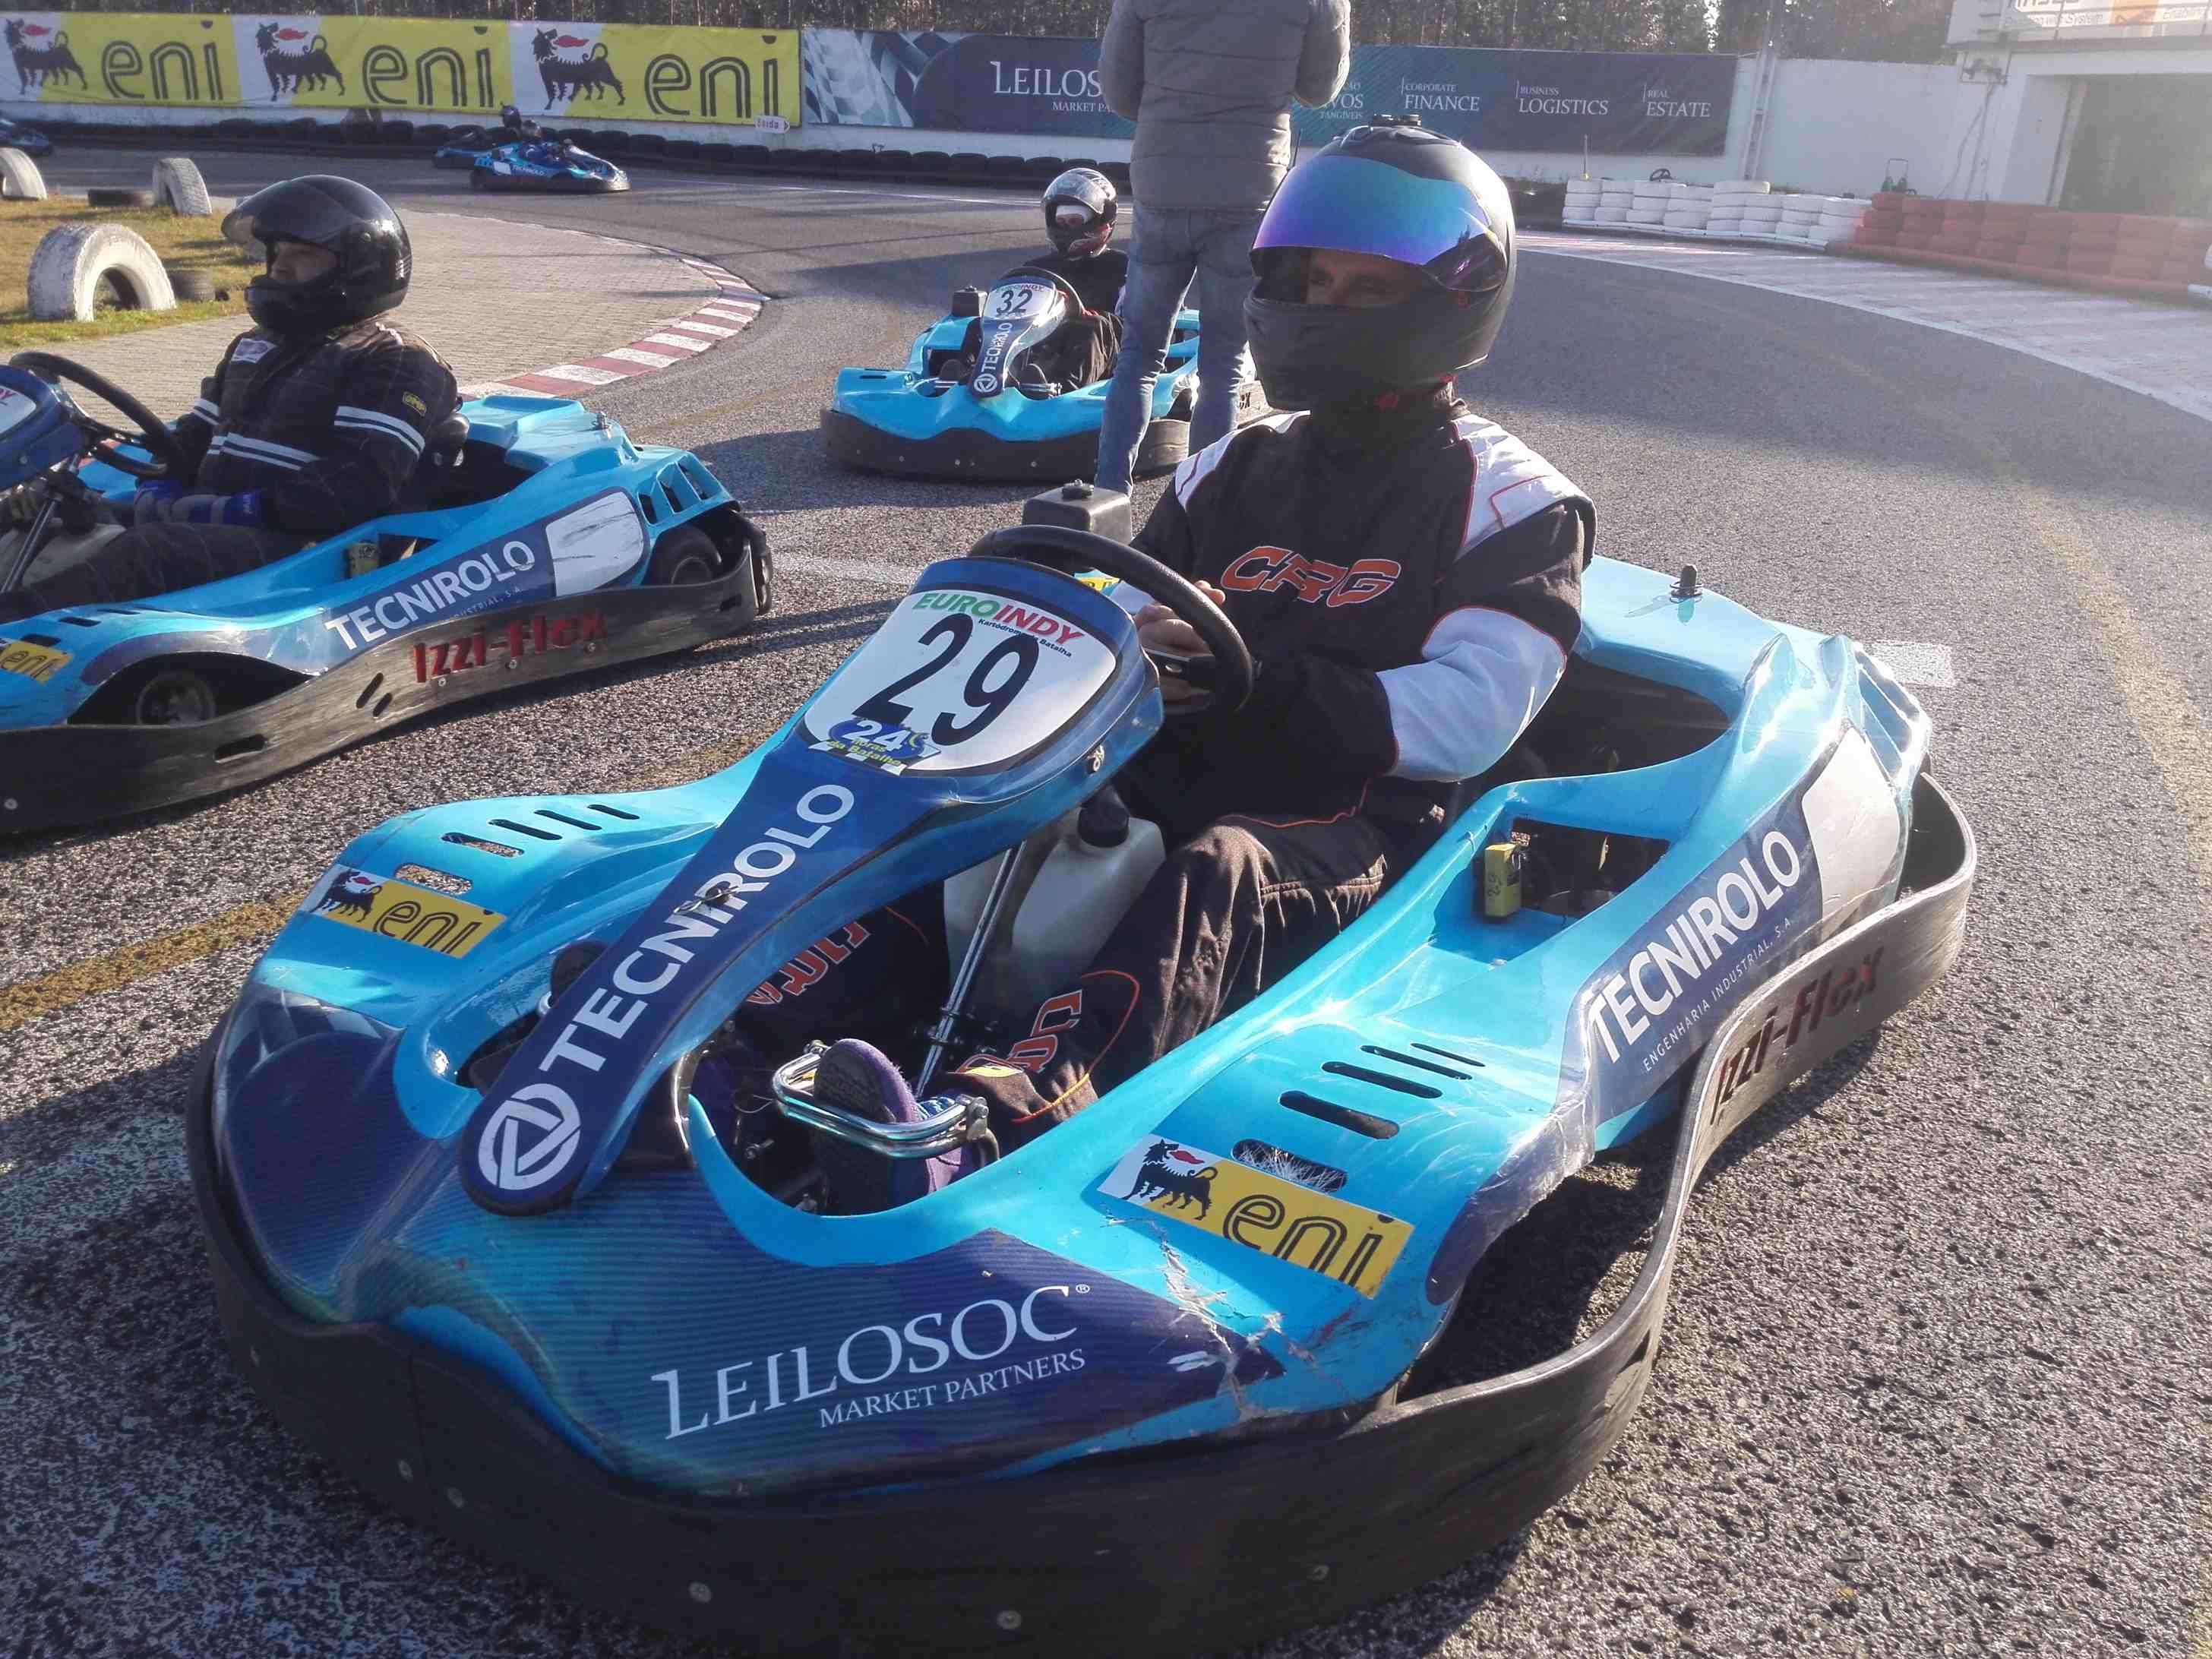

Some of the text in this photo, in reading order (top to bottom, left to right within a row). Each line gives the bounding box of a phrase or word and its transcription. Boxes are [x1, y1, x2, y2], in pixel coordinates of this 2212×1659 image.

[102, 20, 225, 101] eni
[362, 26, 495, 107] eni
[644, 35, 779, 118] eni
[990, 61, 1102, 97] LEILOS
[1052, 101, 1096, 112] MARKET
[1330, 93, 1364, 109] VOS
[1405, 84, 1457, 92] CORPORATE
[1405, 94, 1480, 112] FINANCE
[1518, 98, 1610, 115] LOGISTICS
[1519, 86, 1559, 96] BUSINESS
[1648, 89, 1668, 99] REAL
[1645, 102, 1712, 118] ESTATE
[996, 289, 1033, 315] 32
[324, 540, 536, 650] TECNIROLO
[912, 592, 1085, 645] EUROINDY
[978, 618, 1025, 637] Kartódrom
[1040, 638, 1073, 657] Batalha
[0, 650, 68, 678] eni
[851, 613, 1040, 747] 29
[841, 720, 912, 752] 24
[372, 900, 495, 954] eni
[539, 784, 854, 1073] TECNIROLO
[1588, 831, 1802, 1064] TECNIROLO
[1642, 999, 1711, 1072] ENGENHARIA
[1222, 1194, 1395, 1288] eni
[820, 1348, 1086, 1428] MARKET PARTNERS
